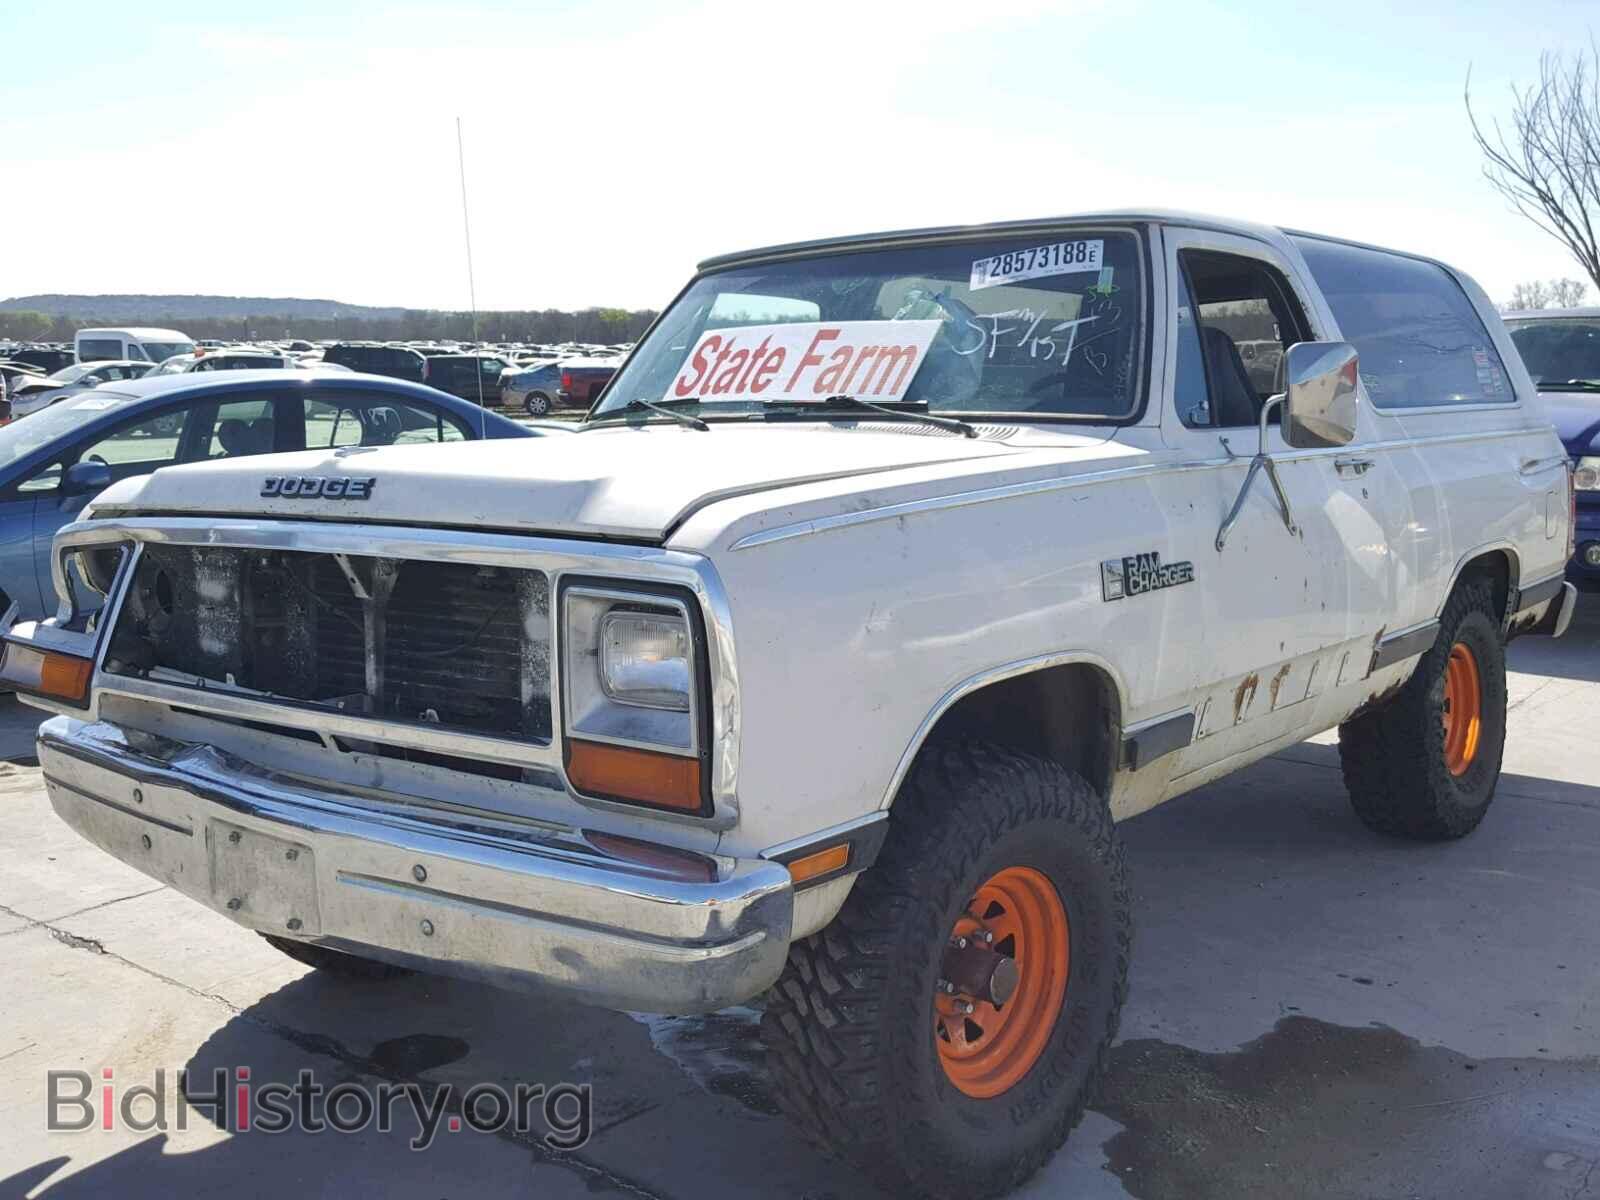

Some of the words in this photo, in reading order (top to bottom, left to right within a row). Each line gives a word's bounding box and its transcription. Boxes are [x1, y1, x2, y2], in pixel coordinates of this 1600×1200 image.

[990, 241, 1087, 278] 28573188
[675, 334, 786, 397] State
[784, 329, 917, 395] Farm
[260, 477, 376, 500] DODGE
[1123, 553, 1160, 577] RAM
[1126, 562, 1194, 595] CHARGER
